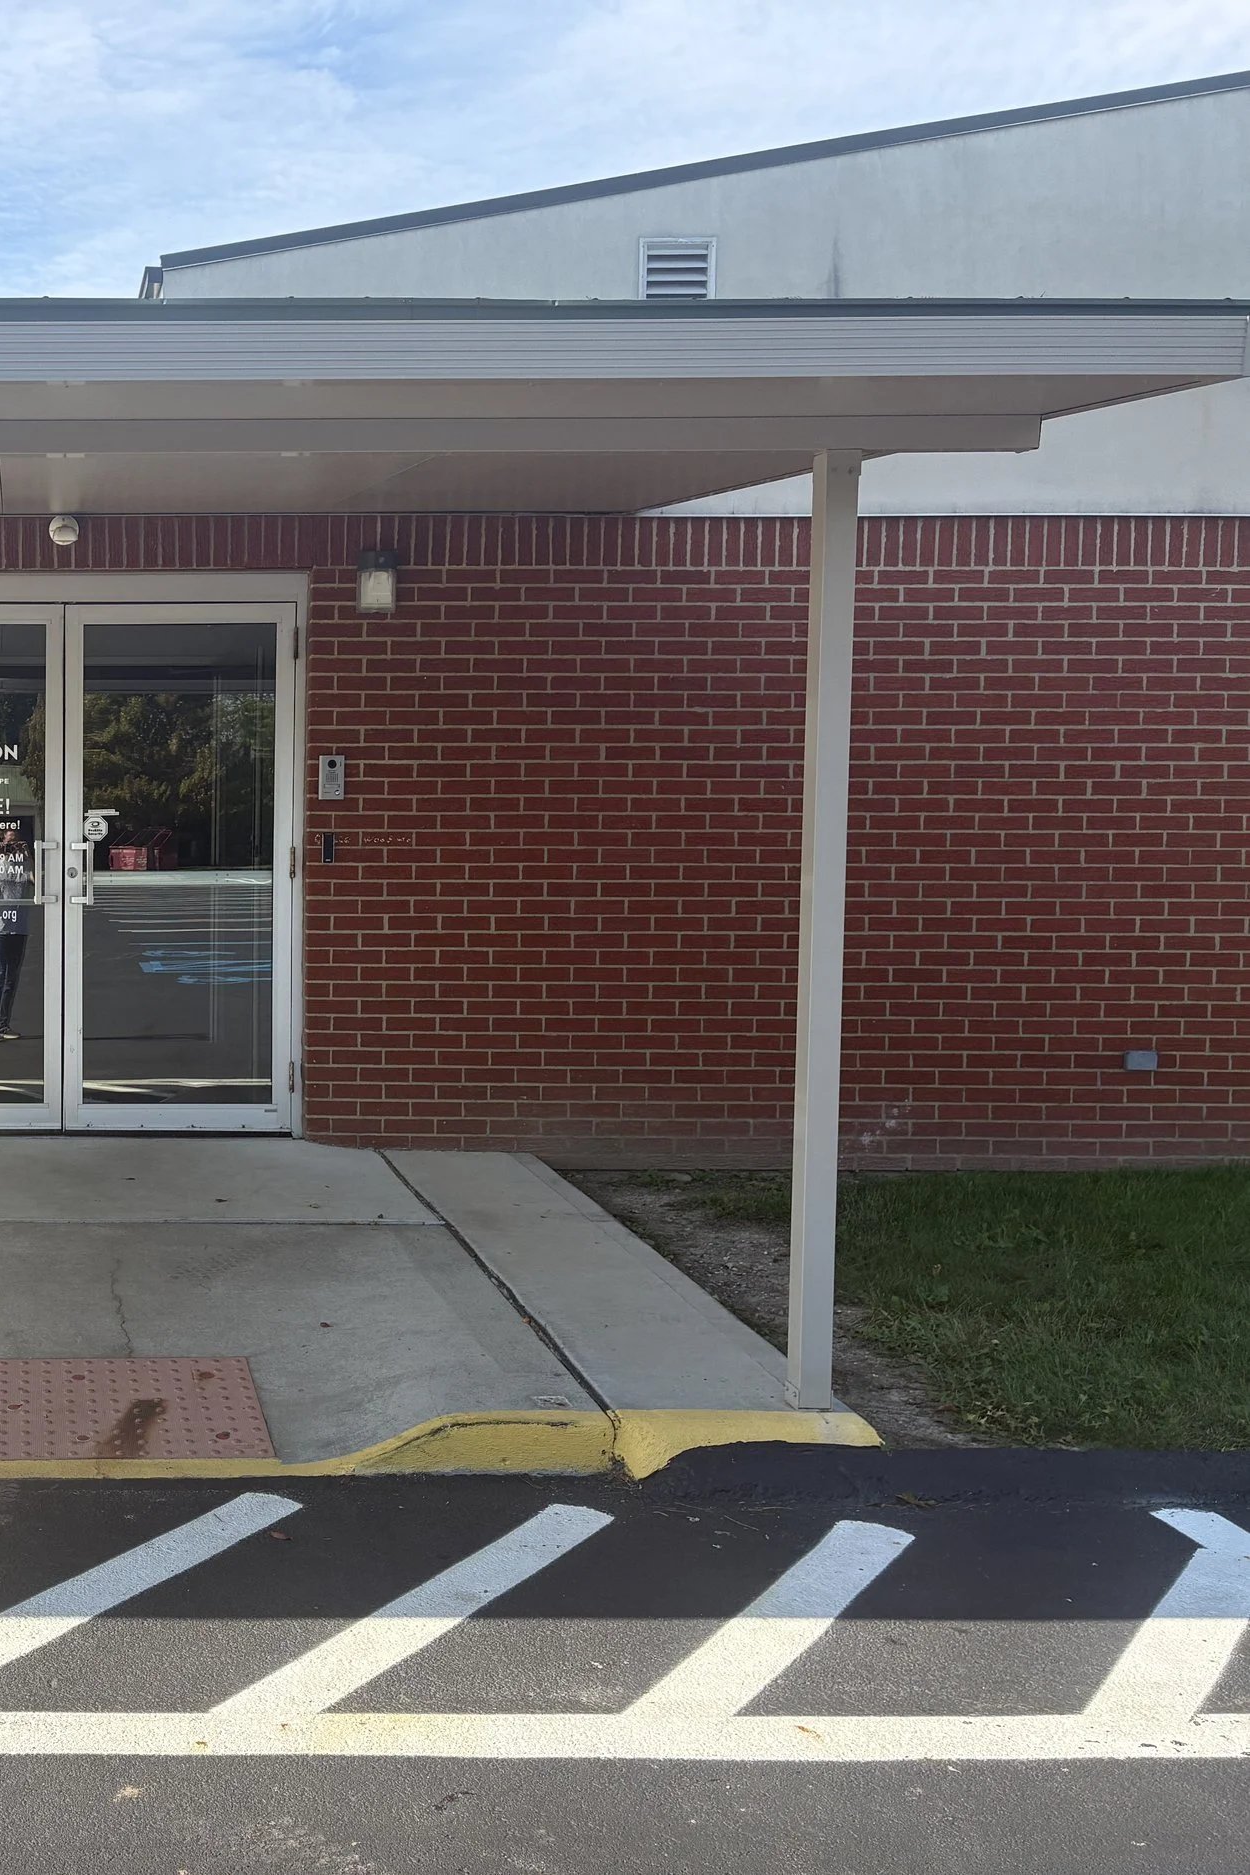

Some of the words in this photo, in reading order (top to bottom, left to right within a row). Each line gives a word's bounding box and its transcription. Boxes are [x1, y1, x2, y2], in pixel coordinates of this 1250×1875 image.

[0, 853, 5, 862] 9
[7, 853, 24, 862] AM
[7, 865, 24, 874] AM
